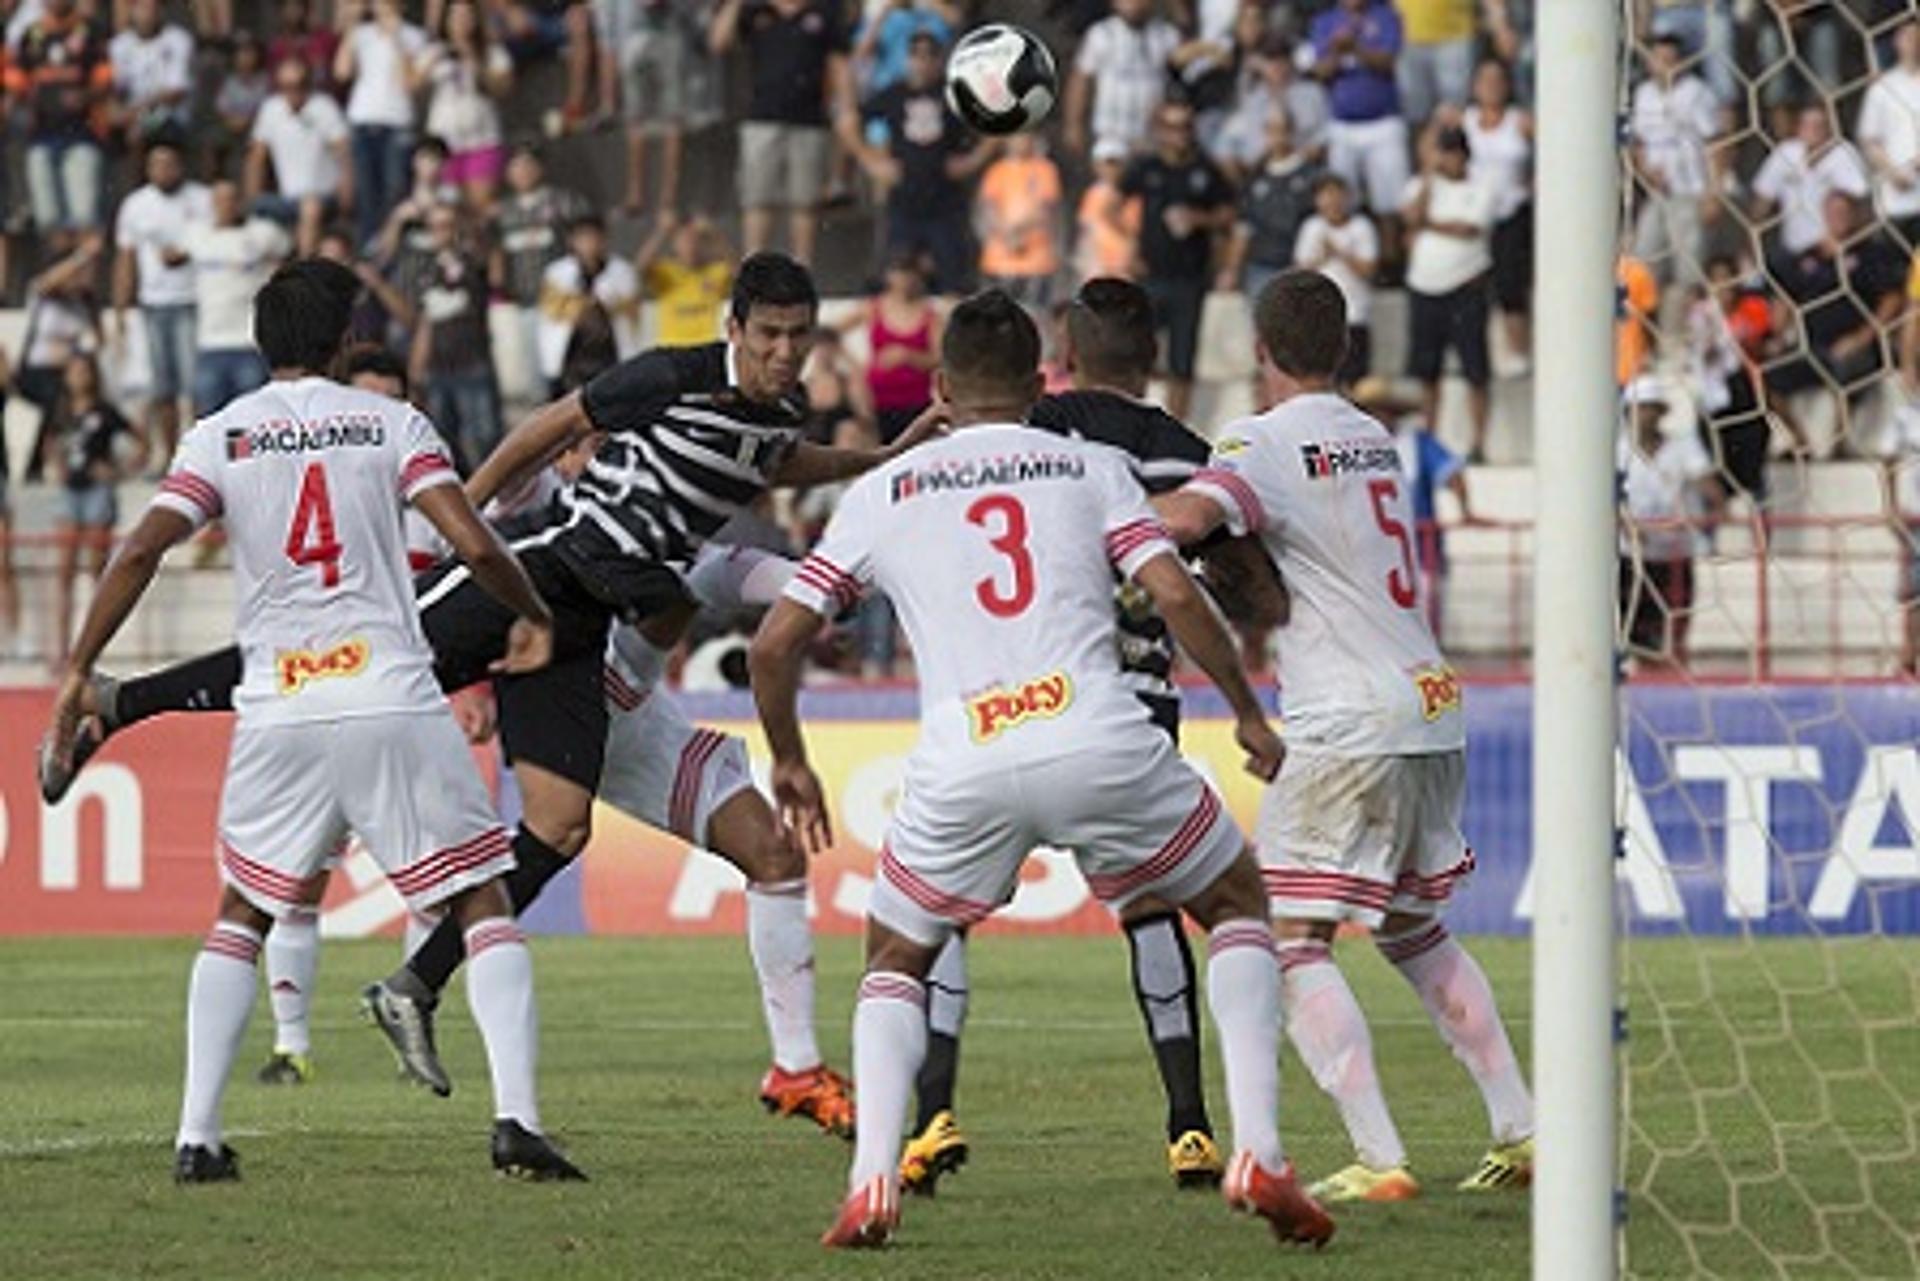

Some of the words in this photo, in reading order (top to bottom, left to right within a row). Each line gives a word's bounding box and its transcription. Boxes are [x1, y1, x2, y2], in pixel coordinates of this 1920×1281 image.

[286, 462, 343, 588] 4
[915, 459, 1086, 492] PACAEMBU
[966, 494, 1034, 619] 3
[1368, 479, 1416, 610] 5
[976, 674, 1065, 737] Poty
